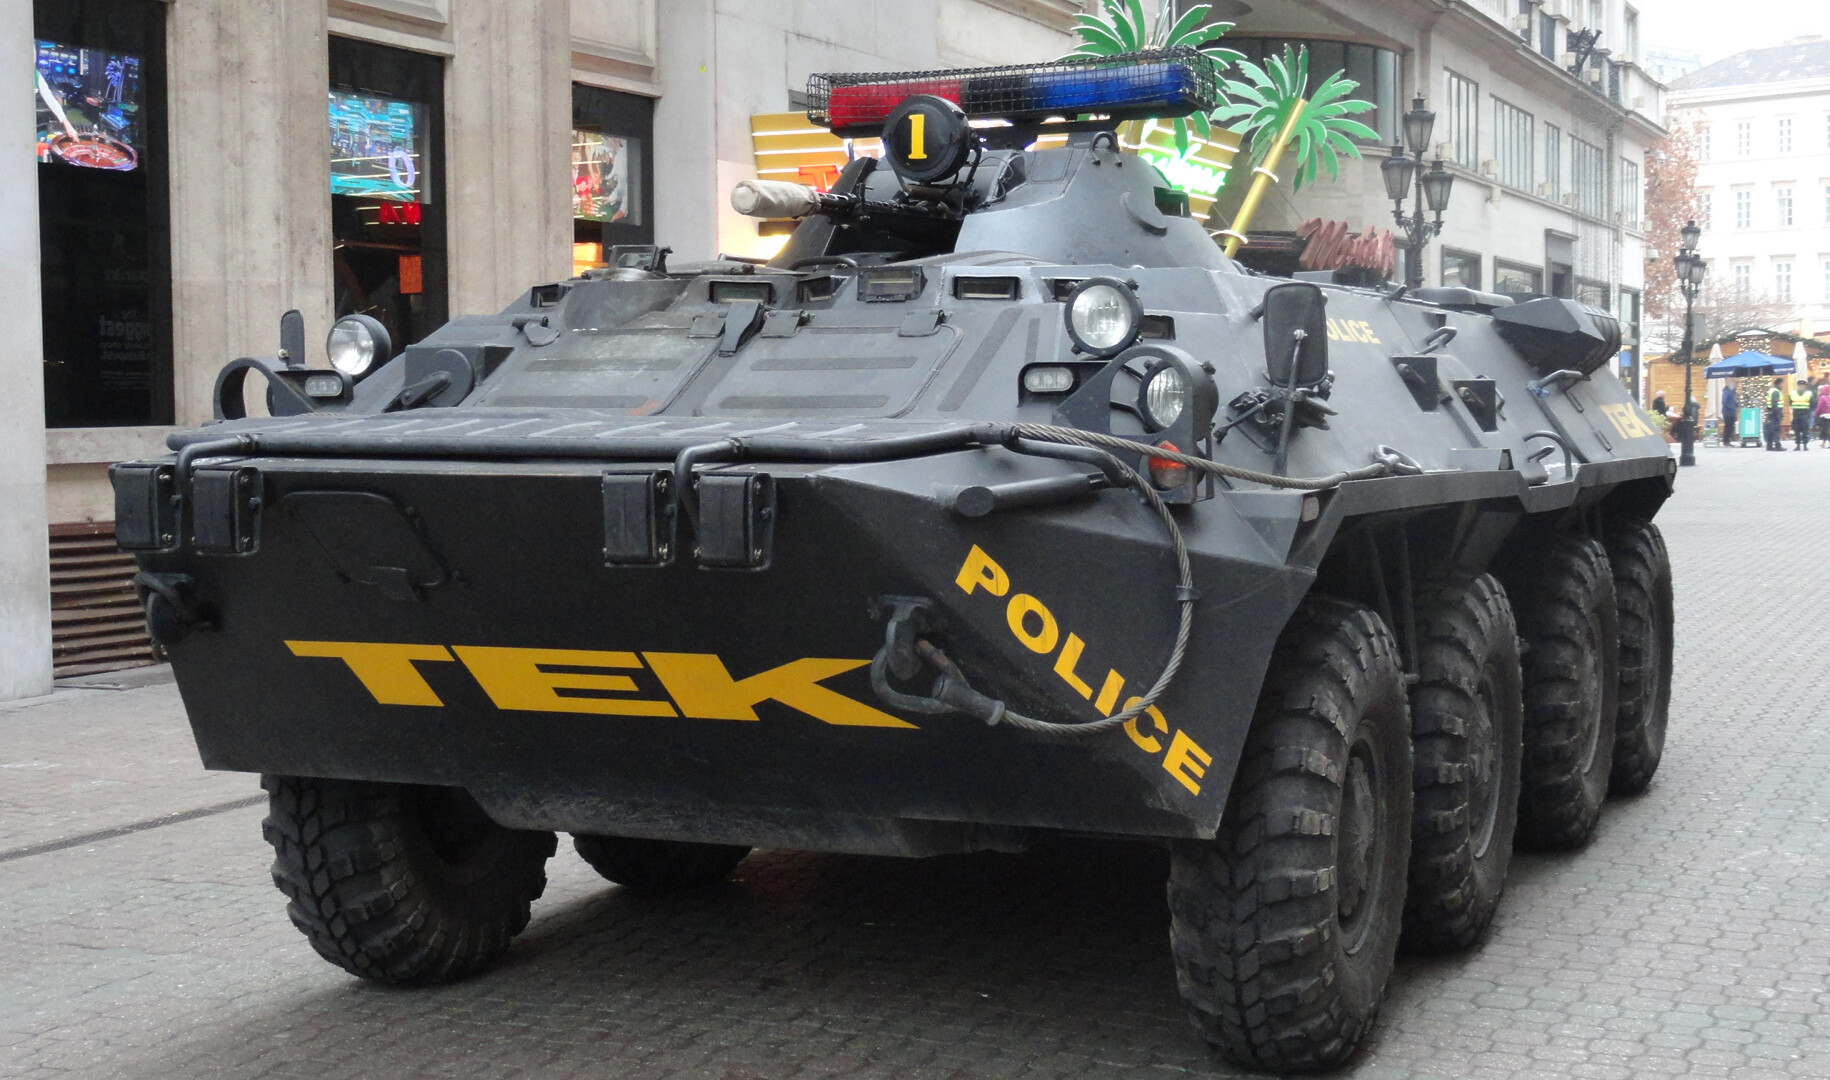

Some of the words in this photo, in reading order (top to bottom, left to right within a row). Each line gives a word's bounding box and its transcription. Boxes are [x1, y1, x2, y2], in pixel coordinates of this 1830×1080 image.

[907, 113, 928, 160] 1
[1326, 317, 1382, 345] OLICE
[1599, 401, 1655, 440] TEK
[283, 639, 922, 730] TEK
[955, 543, 1213, 797] POLICE
